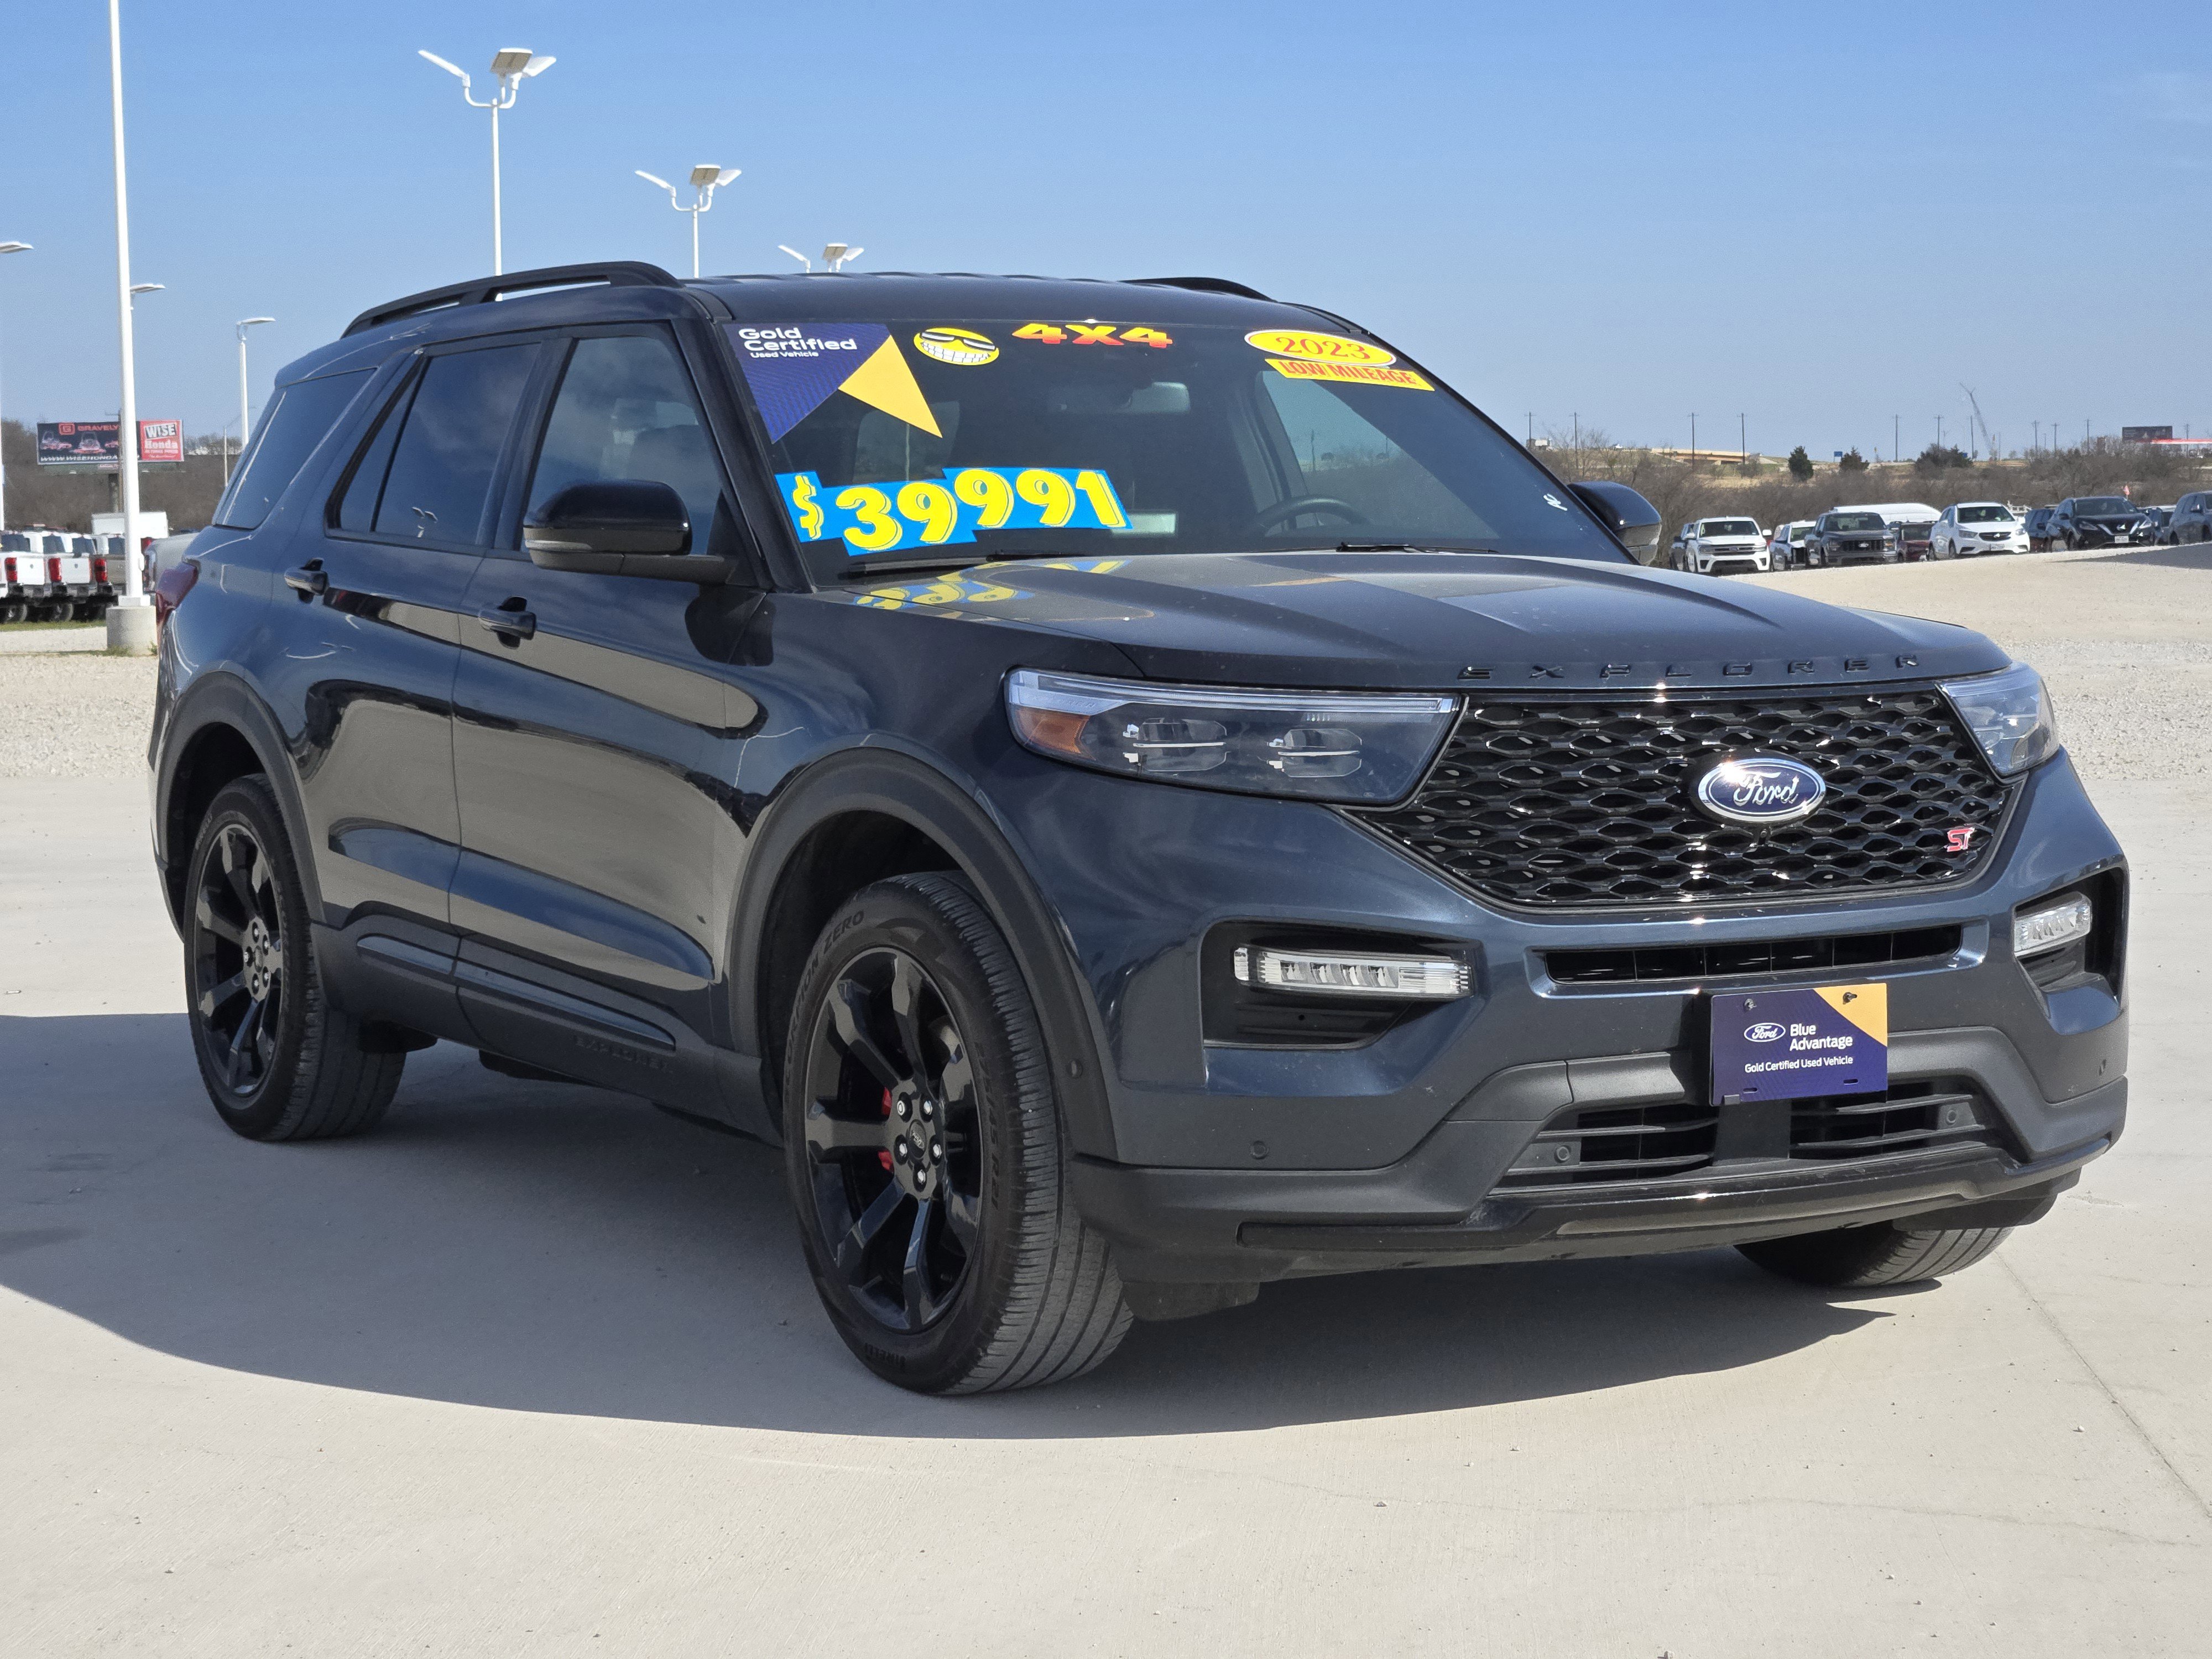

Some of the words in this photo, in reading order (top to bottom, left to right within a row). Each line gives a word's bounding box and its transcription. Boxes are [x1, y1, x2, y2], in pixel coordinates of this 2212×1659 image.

[738, 327, 802, 340] Gold
[1012, 323, 1173, 348] 4X4
[744, 338, 857, 351] Certified
[1275, 337, 1370, 359] 2023
[1277, 361, 1326, 376] LOW
[1327, 363, 1417, 385] MILEAGE
[145, 424, 176, 438] WISE
[144, 440, 178, 448] Honda
[1457, 654, 1919, 680] EXPLORER
[1733, 771, 1799, 807] Ford
[1947, 827, 1975, 852] ST
[823, 910, 865, 954] ZERO
[1751, 1025, 1778, 1040] Ford
[1790, 1024, 1817, 1037] Blue
[1790, 1036, 1853, 1051] Advantage
[1745, 1062, 1765, 1073] Gold
[1765, 1058, 1799, 1071] Certified
[1801, 1057, 1823, 1068] Used
[1823, 1055, 1854, 1066] Vehicle
